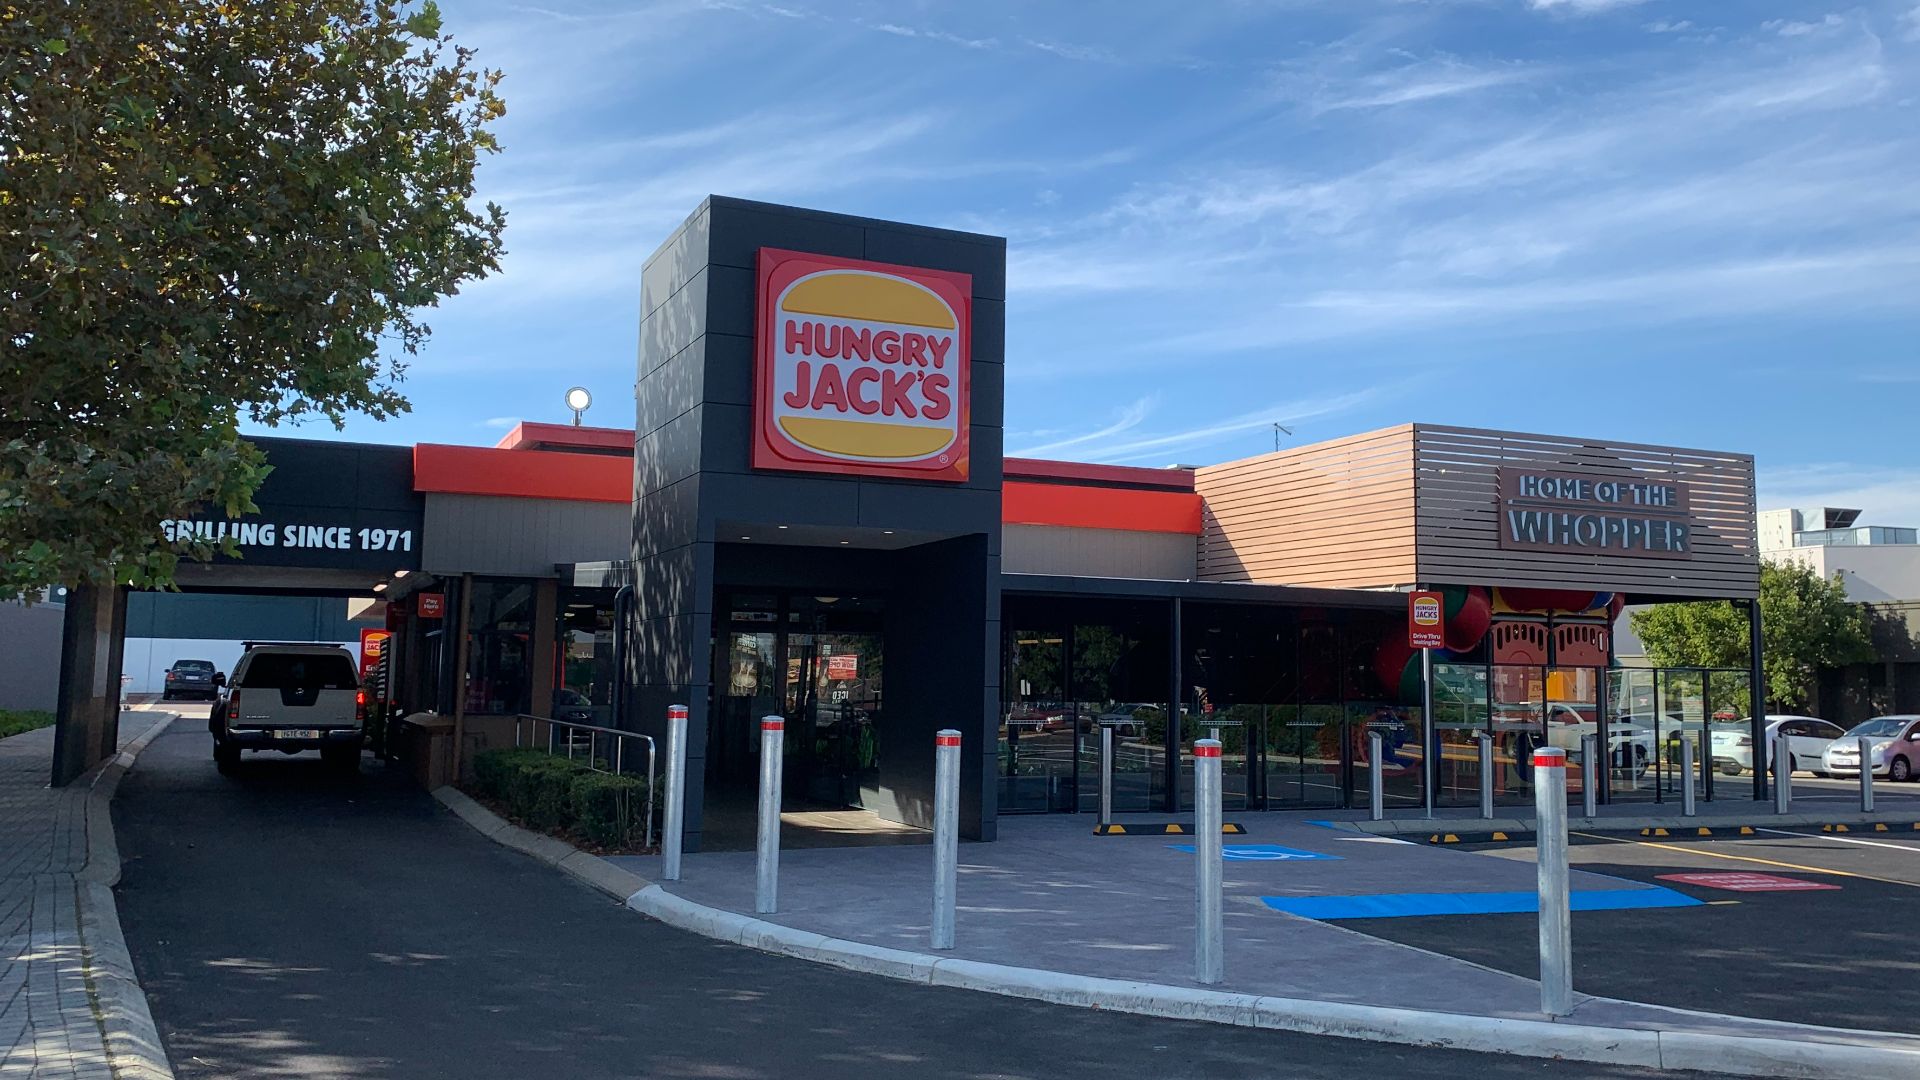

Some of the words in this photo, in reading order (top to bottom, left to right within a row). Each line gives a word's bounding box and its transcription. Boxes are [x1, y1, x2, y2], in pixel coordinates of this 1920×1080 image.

[785, 320, 951, 369] HUNGRY
[784, 361, 951, 420] JACK'S
[1519, 475, 1592, 500] HOME
[1594, 481, 1631, 503] OF
[1629, 483, 1677, 506] THE
[283, 525, 350, 549] SINCE
[358, 528, 412, 552] 1971
[1507, 509, 1690, 552] WHOPPER
